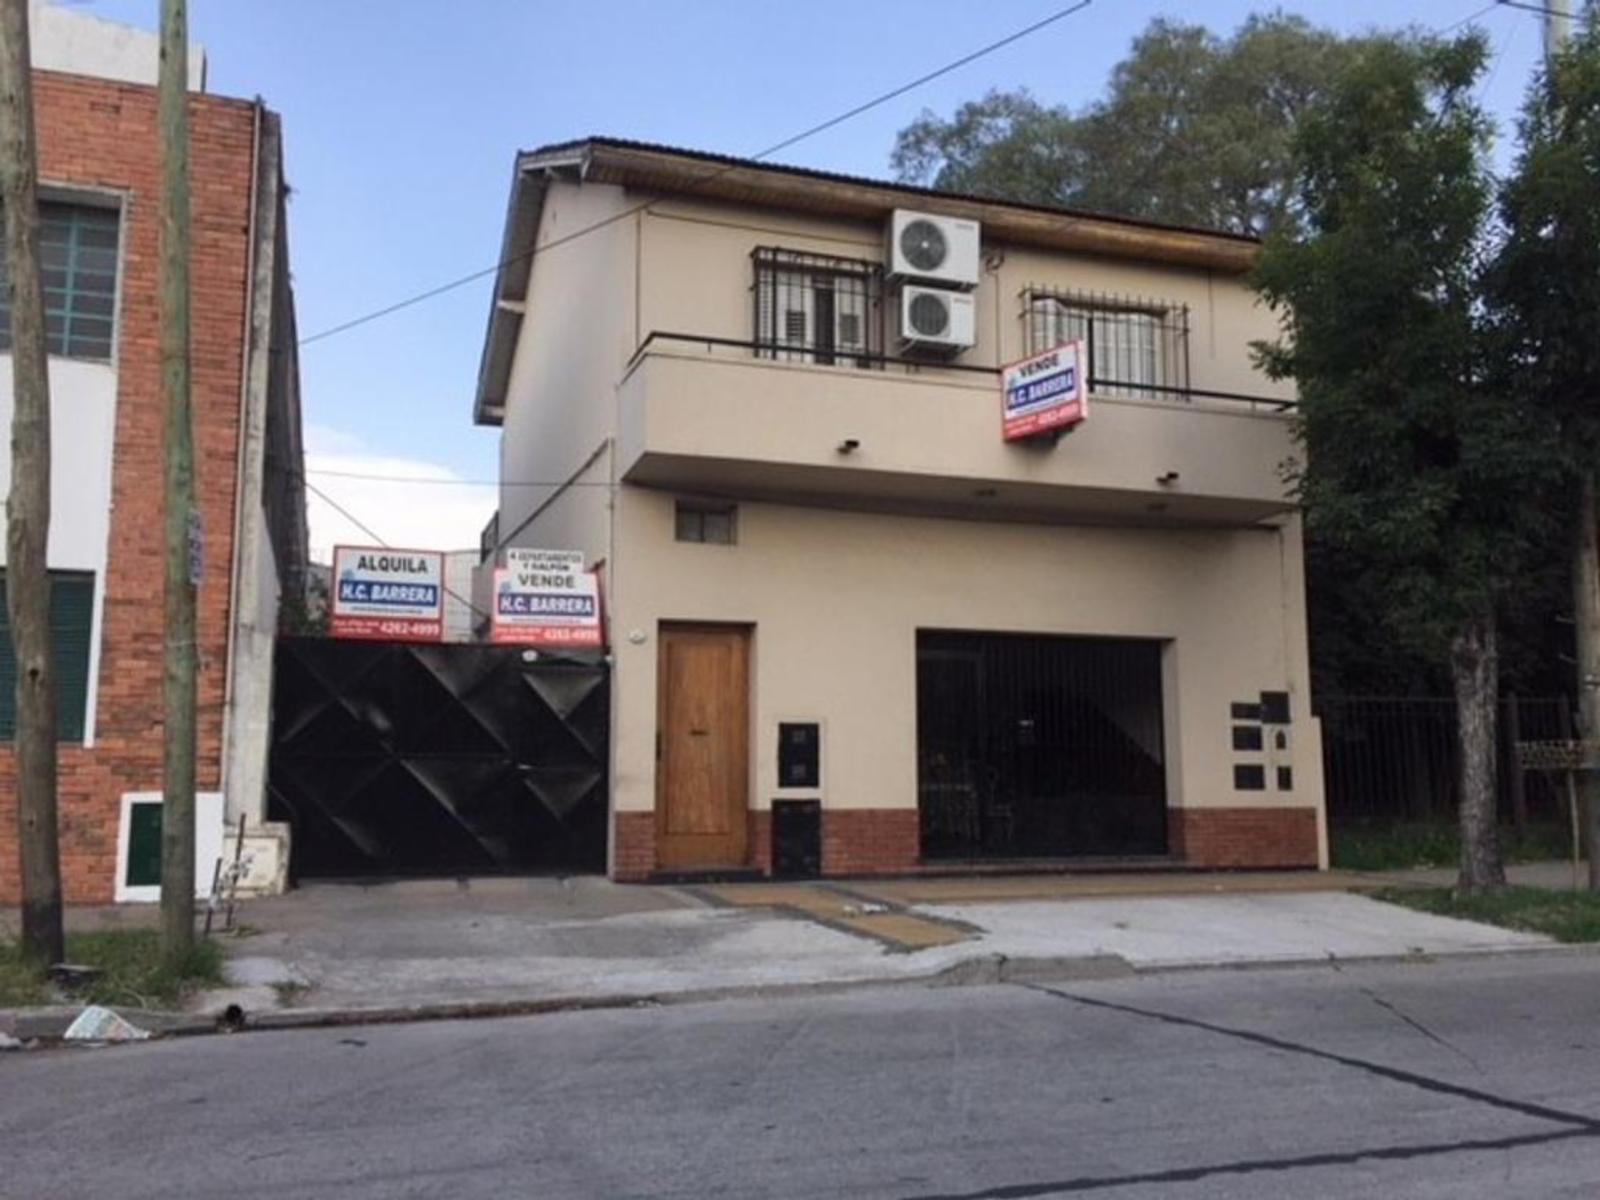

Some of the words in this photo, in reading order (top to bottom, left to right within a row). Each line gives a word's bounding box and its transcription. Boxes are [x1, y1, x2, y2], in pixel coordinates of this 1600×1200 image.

[1019, 353, 1059, 377] VENDE
[357, 555, 428, 573] ALQUILA
[518, 574, 575, 588] VENDE
[370, 585, 434, 603] BARRERA
[529, 597, 592, 613] BARRERA
